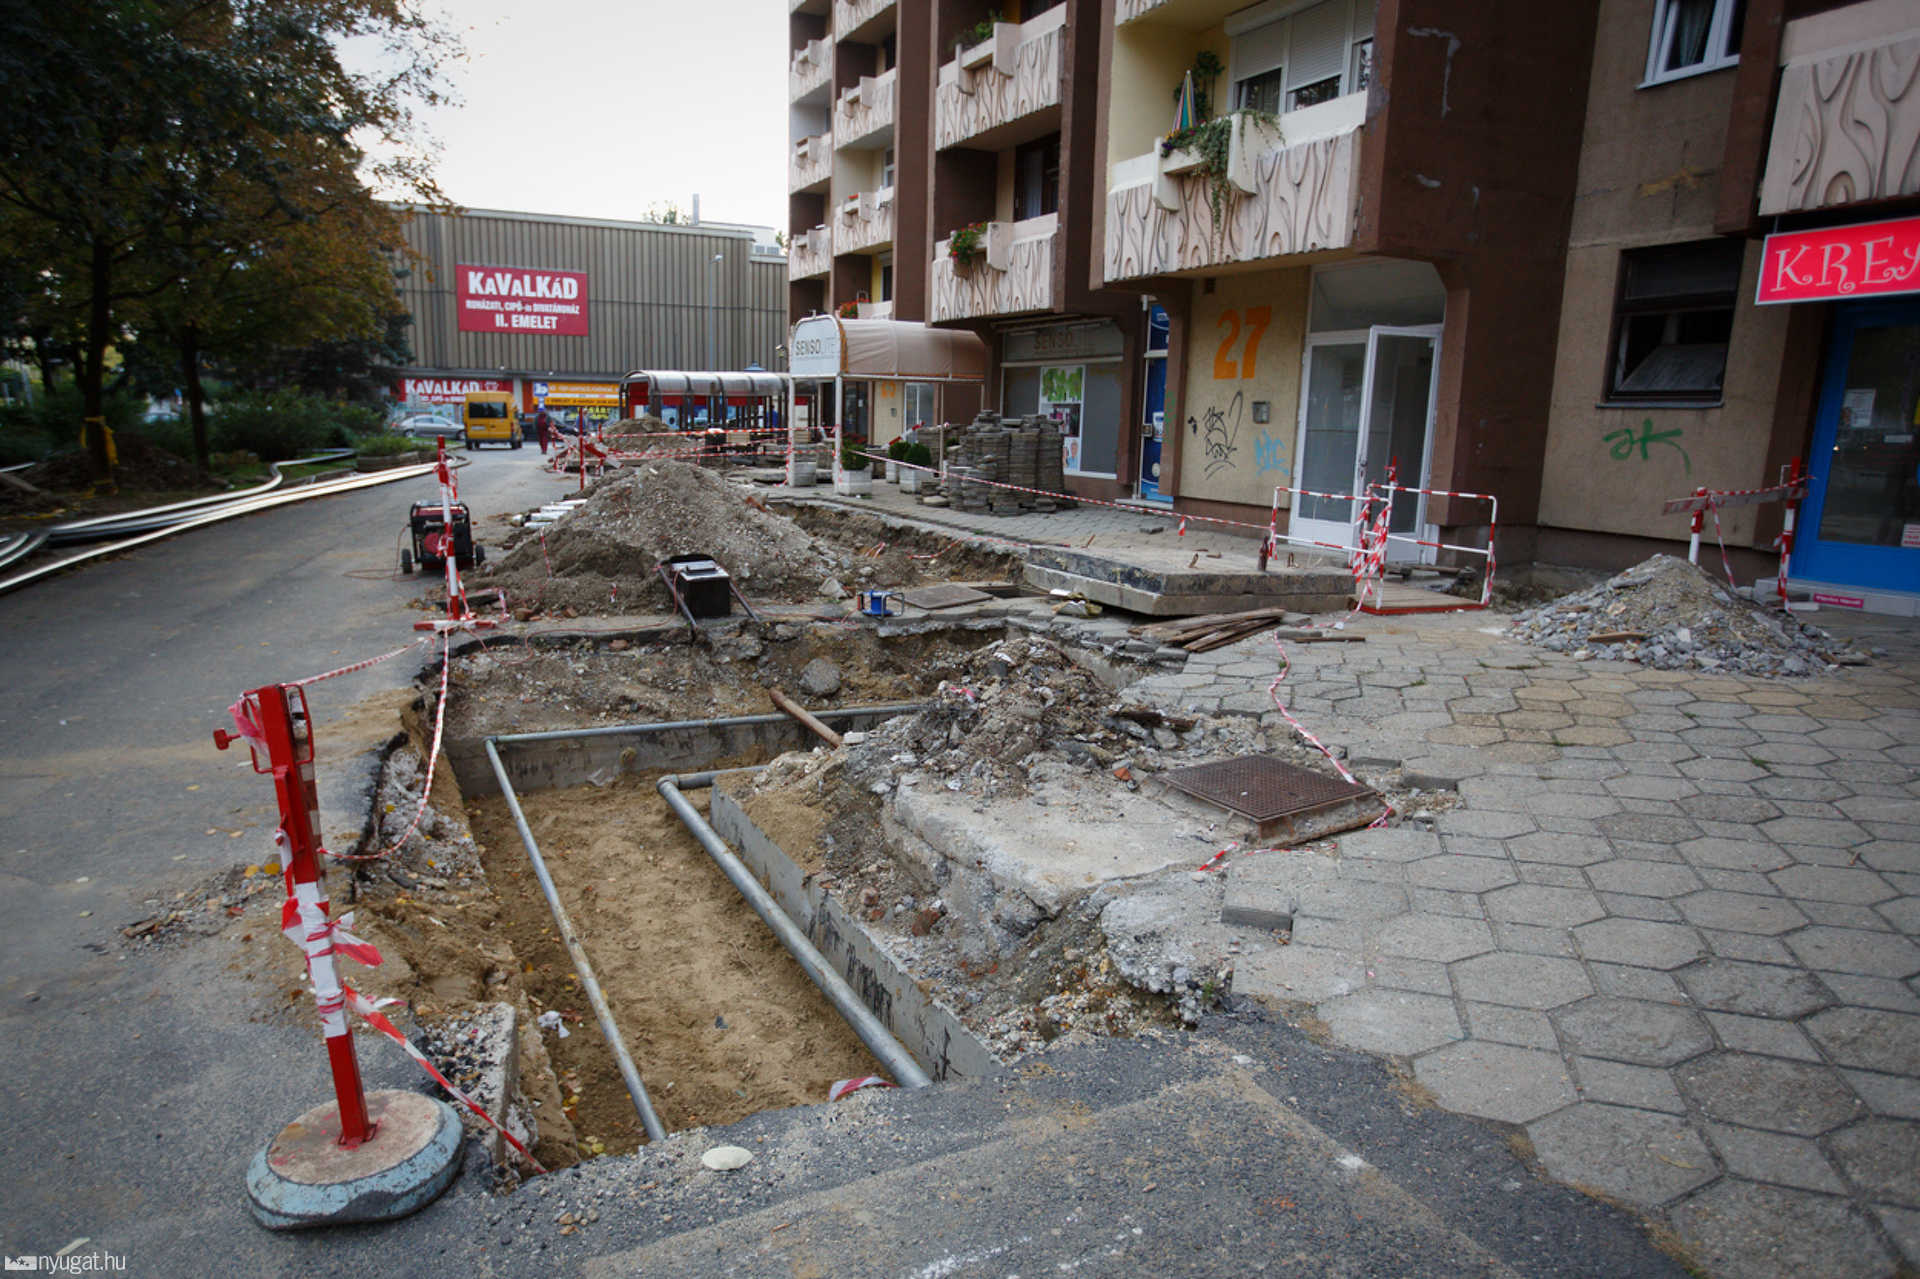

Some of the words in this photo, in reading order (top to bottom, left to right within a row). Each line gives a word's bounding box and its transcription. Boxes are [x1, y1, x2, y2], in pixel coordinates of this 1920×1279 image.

[468, 271, 578, 299] KAVALKÁD
[495, 313, 509, 328] II.
[511, 314, 559, 330] EMELET
[1214, 304, 1273, 379] 27
